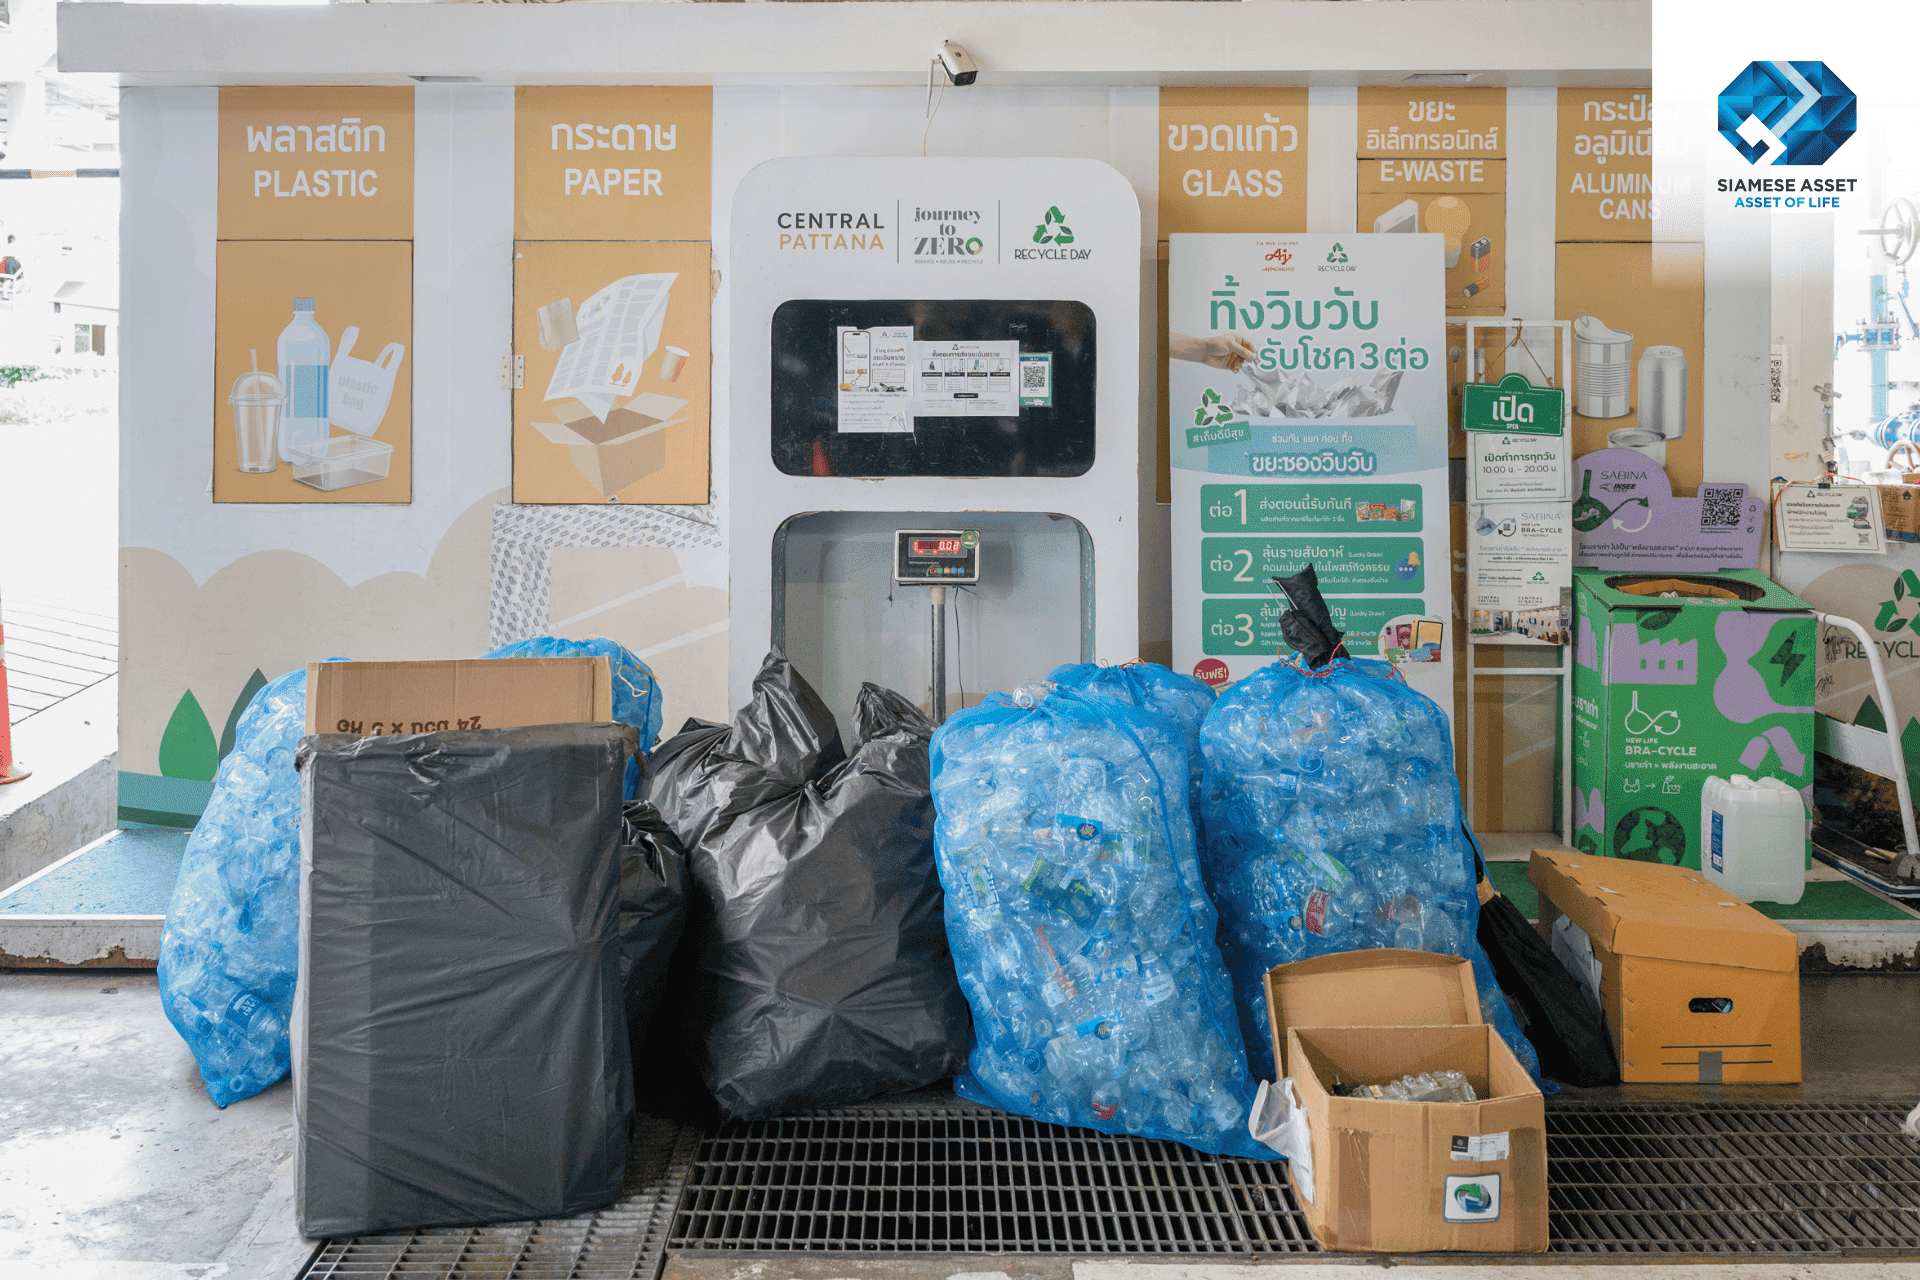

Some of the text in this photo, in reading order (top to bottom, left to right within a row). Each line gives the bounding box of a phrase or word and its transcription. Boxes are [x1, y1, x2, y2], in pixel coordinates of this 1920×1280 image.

[1409, 101, 1456, 122] ขยะ
[247, 117, 385, 152] พลาสติก
[551, 123, 677, 151] กระดาษ
[1168, 113, 1298, 152] ขวดแก้ว
[1366, 126, 1499, 150] อิเล็กทรอนิกส์
[1380, 160, 1484, 182] E-WASTE
[254, 169, 378, 197] PLASTIC
[564, 168, 663, 196] PAPER
[1182, 169, 1283, 198] GLASS
[914, 207, 983, 225] journey
[1600, 198, 1662, 220] CANS
[777, 212, 885, 229] CENTRAL
[938, 222, 957, 236] to
[779, 234, 885, 250] PATTANA
[914, 237, 984, 256] ZERO
[1014, 248, 1092, 260] RECYCLE DAY
[1210, 275, 1379, 330] ทิ้งวิบวับ
[1259, 335, 1429, 370] รับโชค 3 ต่อ
[337, 375, 378, 396] plastic
[342, 392, 365, 411] bag
[1492, 394, 1534, 423] เปิด
[1192, 428, 1244, 444] #เก็บดีมีสุข
[1272, 431, 1353, 443] ร่วมกัน แยก ก่อน ทิ้ง
[1253, 451, 1373, 472] ขยะซองวิบวับ
[1484, 451, 1556, 463] เปิดทำการทุกวัน
[1524, 465, 1549, 473] 20.00
[1600, 471, 1648, 480] SABINA
[1209, 488, 1247, 525] ต่อ 1
[1259, 493, 1352, 510] ส่งตอนนี้รับทันที
[1521, 512, 1561, 520] SABINA
[1262, 544, 1345, 562] ลุ้นรายสัปดาห์
[1210, 549, 1254, 582] ต่อ 2
[1211, 613, 1254, 647] ต่อ 3
[1845, 640, 1920, 659] REYCL
[1195, 667, 1228, 680] รับฟรี!
[457, 715, 482, 730] 24
[1625, 745, 1697, 756] BRA-CYCLE
[1625, 760, 1652, 769] บราเก่า
[1661, 761, 1717, 769] พลังงานสะอาด
